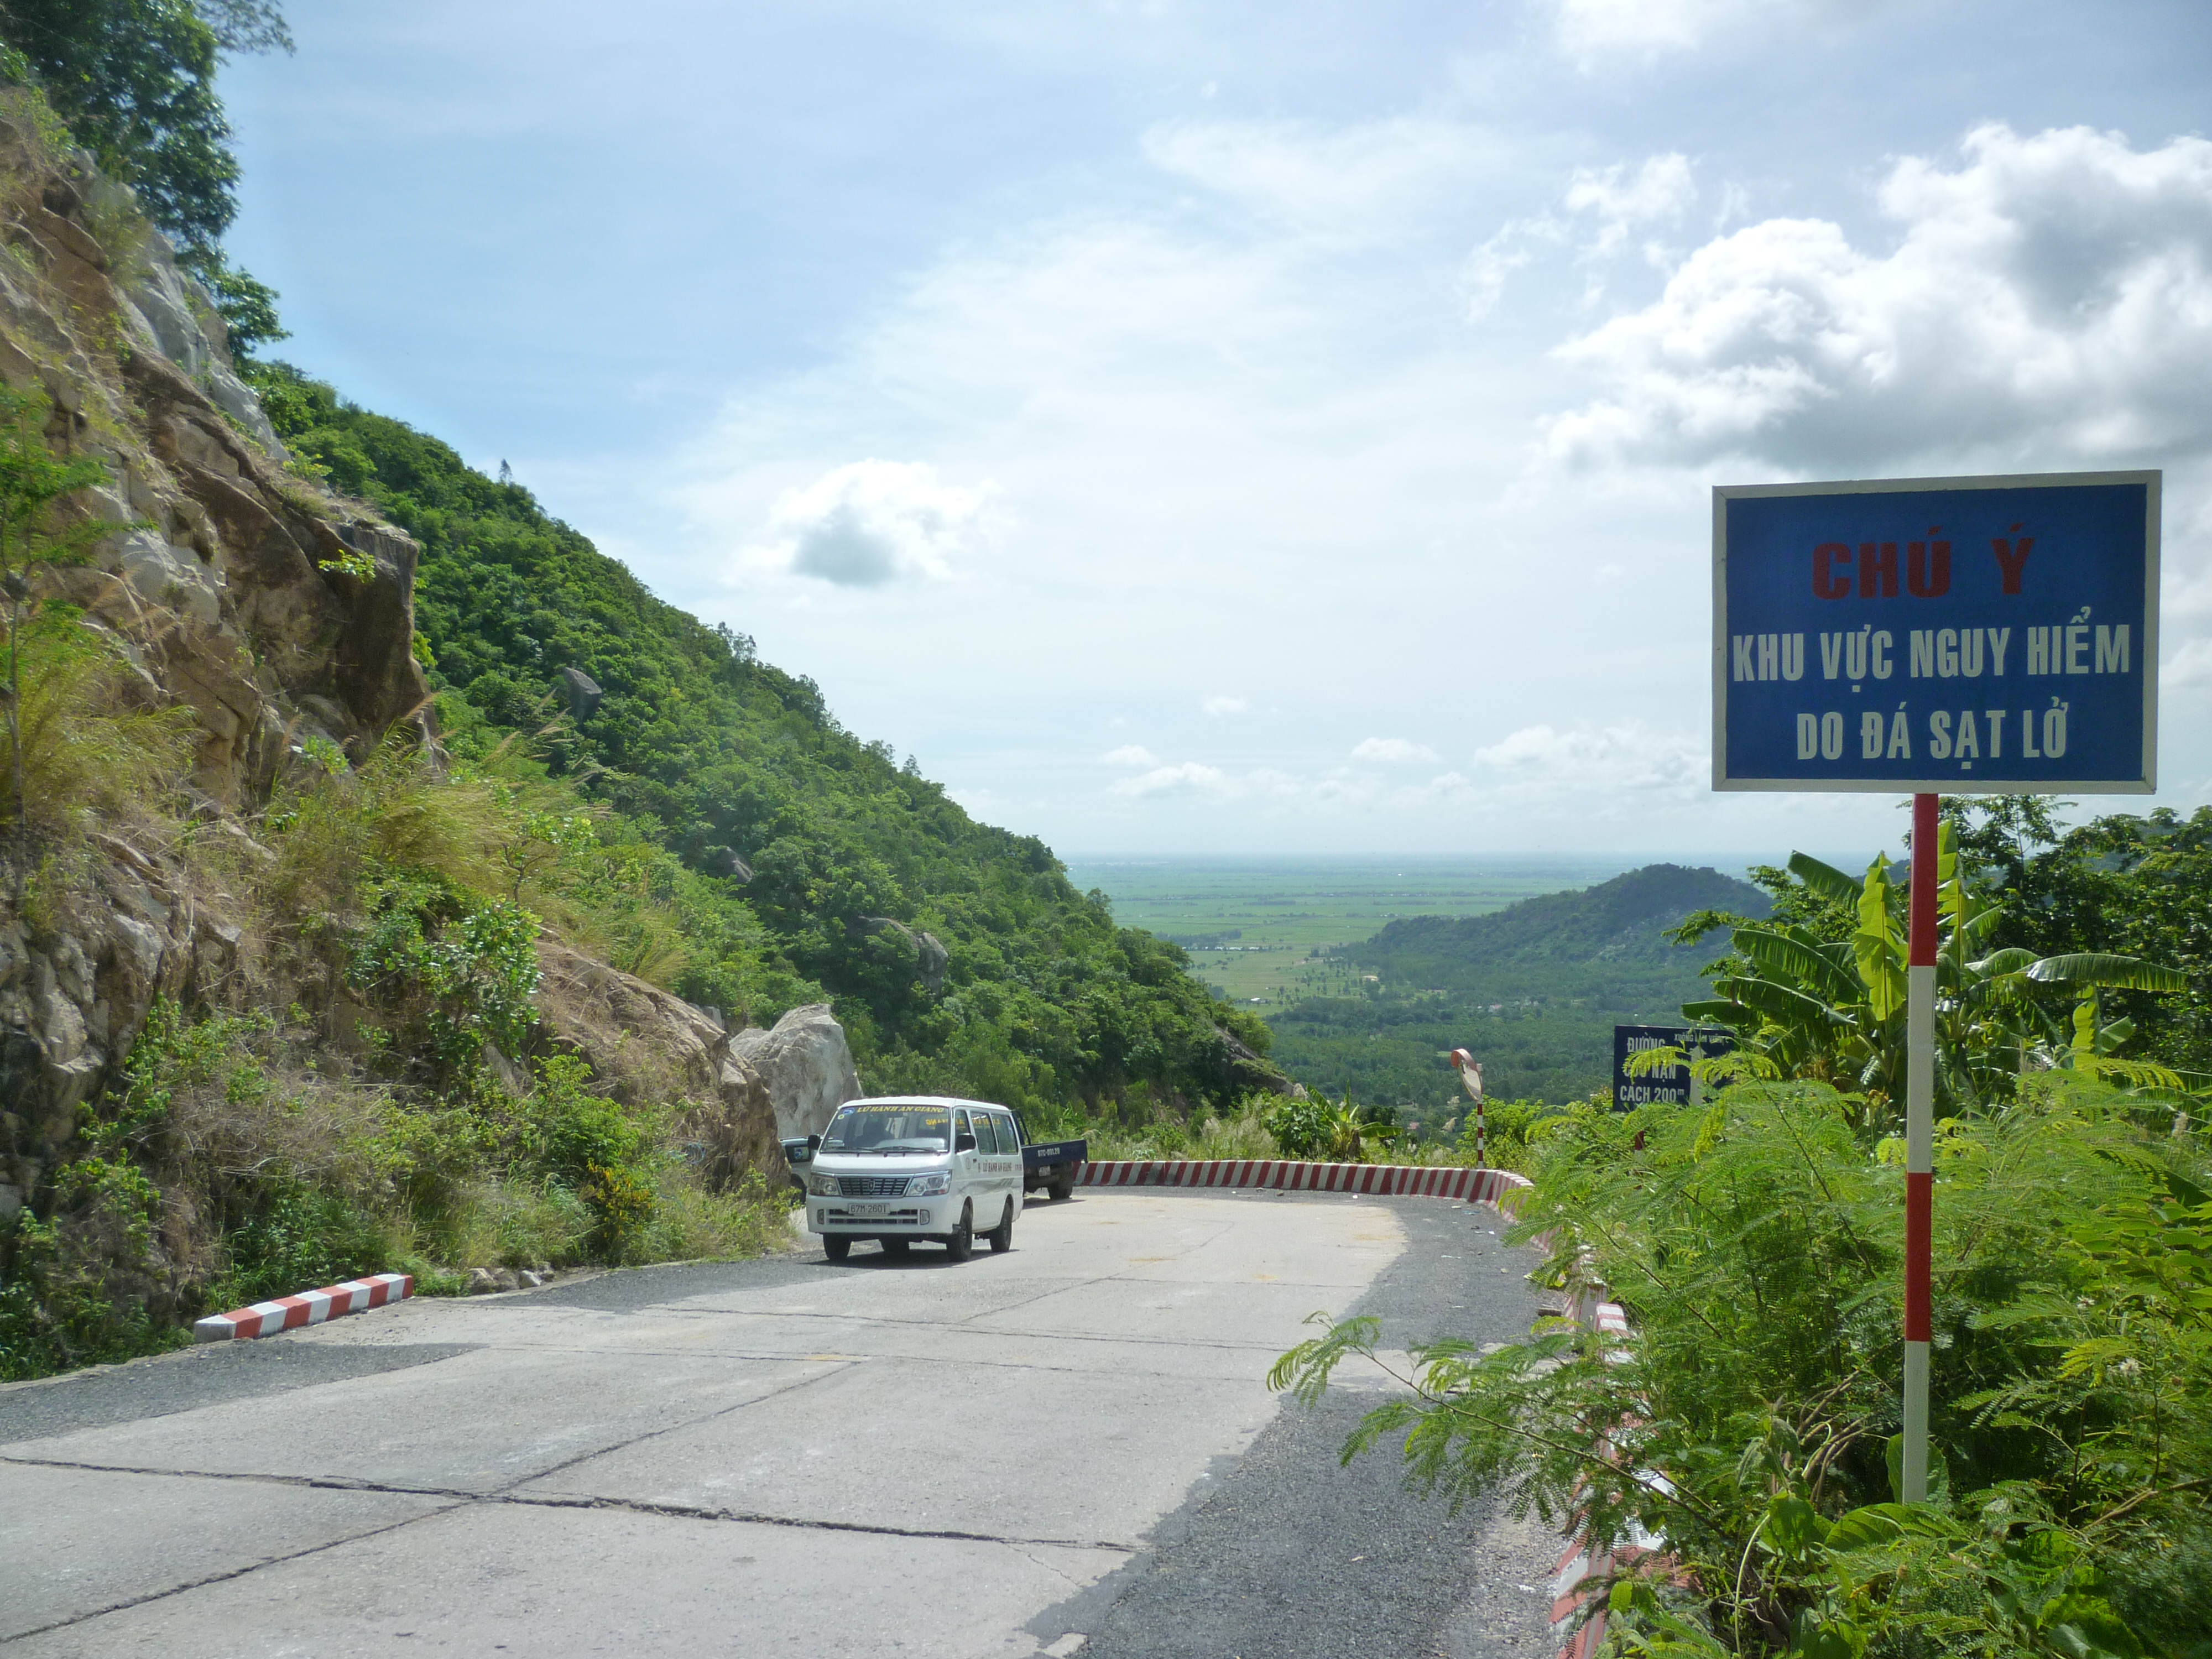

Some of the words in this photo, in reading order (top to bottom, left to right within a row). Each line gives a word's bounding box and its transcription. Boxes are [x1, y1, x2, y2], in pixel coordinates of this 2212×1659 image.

[1812, 525, 1952, 600] CHÚ
[1991, 523, 2036, 594] Ý
[1733, 632, 1804, 682] KHU
[1820, 623, 1893, 692] VỰC
[1910, 627, 2011, 679] NGUY
[2027, 606, 2131, 676] HIỂM
[1797, 712, 1843, 760] DO
[1860, 701, 1911, 760] ĐÁ
[1929, 709, 2006, 769] SẠT
[2022, 696, 2069, 759] LỞ
